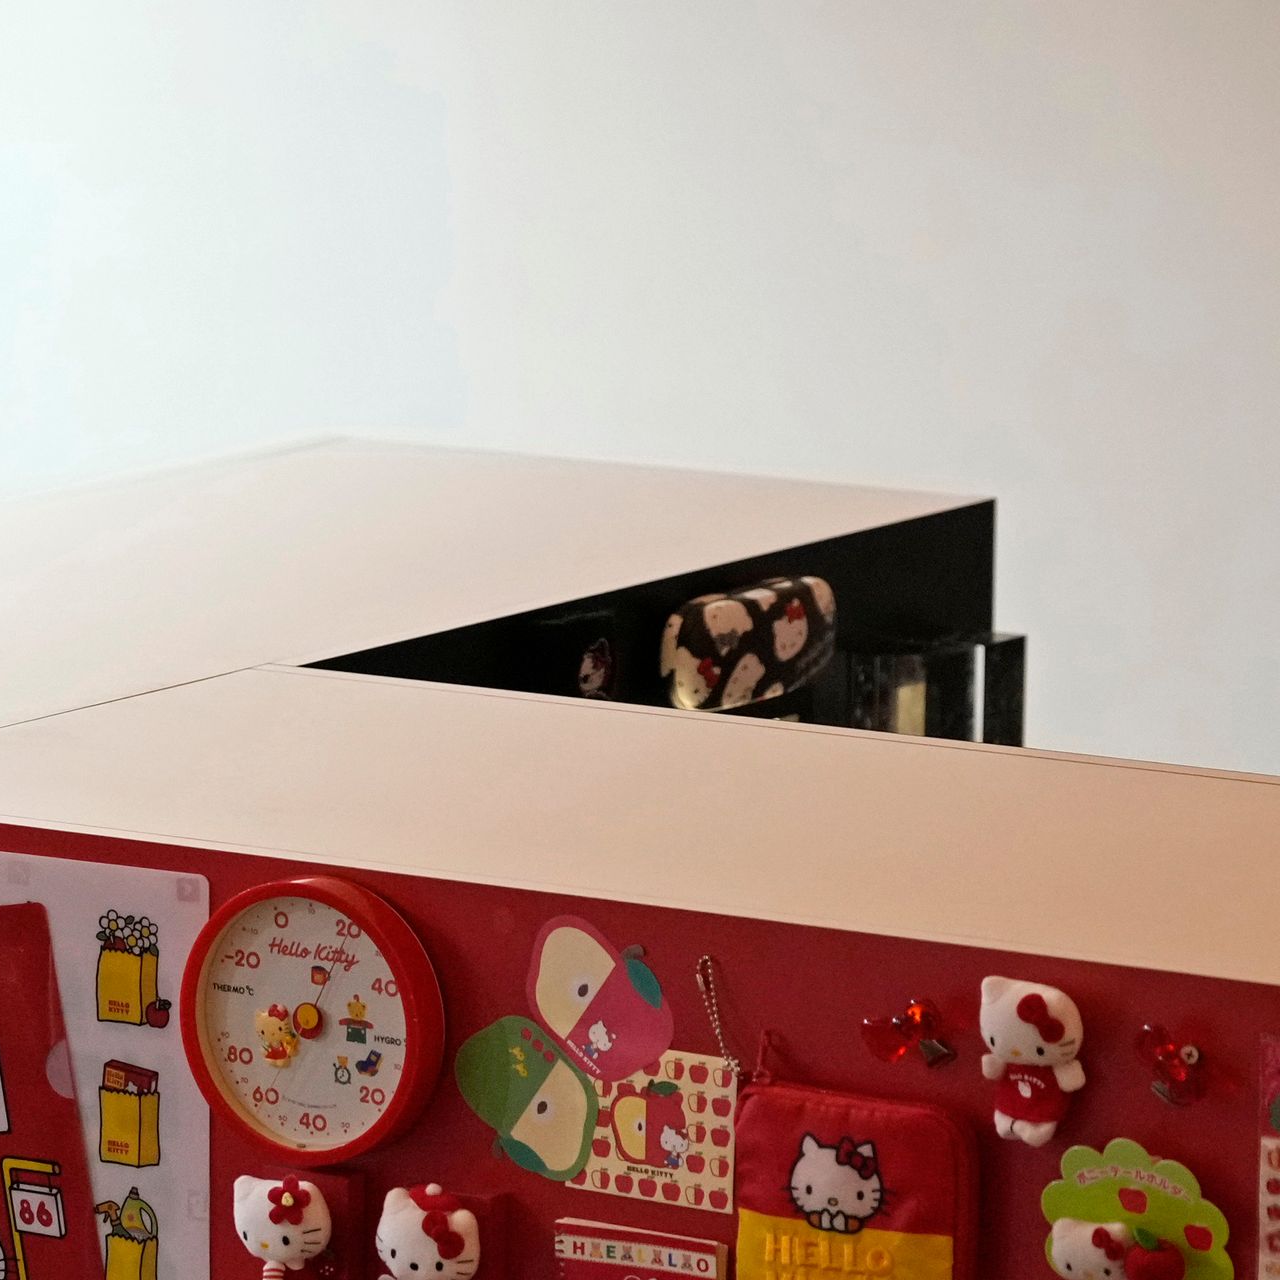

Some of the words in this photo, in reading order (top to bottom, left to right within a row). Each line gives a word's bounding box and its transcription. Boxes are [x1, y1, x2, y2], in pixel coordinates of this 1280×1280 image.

[274, 911, 289, 929] 0
[336, 919, 362, 939] 20
[224, 950, 260, 969] -20
[269, 937, 311, 958] Hello
[313, 943, 359, 971] Kitty
[212, 982, 245, 995] THERMO
[371, 978, 398, 997] 40
[108, 1000, 130, 1009] HELLO
[108, 1007, 130, 1015] KITTY
[374, 1034, 402, 1046] HYGRO
[227, 1046, 253, 1064] 80
[252, 1086, 279, 1105] 60
[359, 1086, 385, 1105] 20
[299, 1112, 327, 1131] 40
[108, 1140, 129, 1149] HELLO
[108, 1147, 129, 1155] KITTY
[626, 1165, 649, 1175] HELLO
[651, 1169, 674, 1179] KITTY
[19, 1199, 53, 1228] 86
[764, 1233, 895, 1277] HELLO
